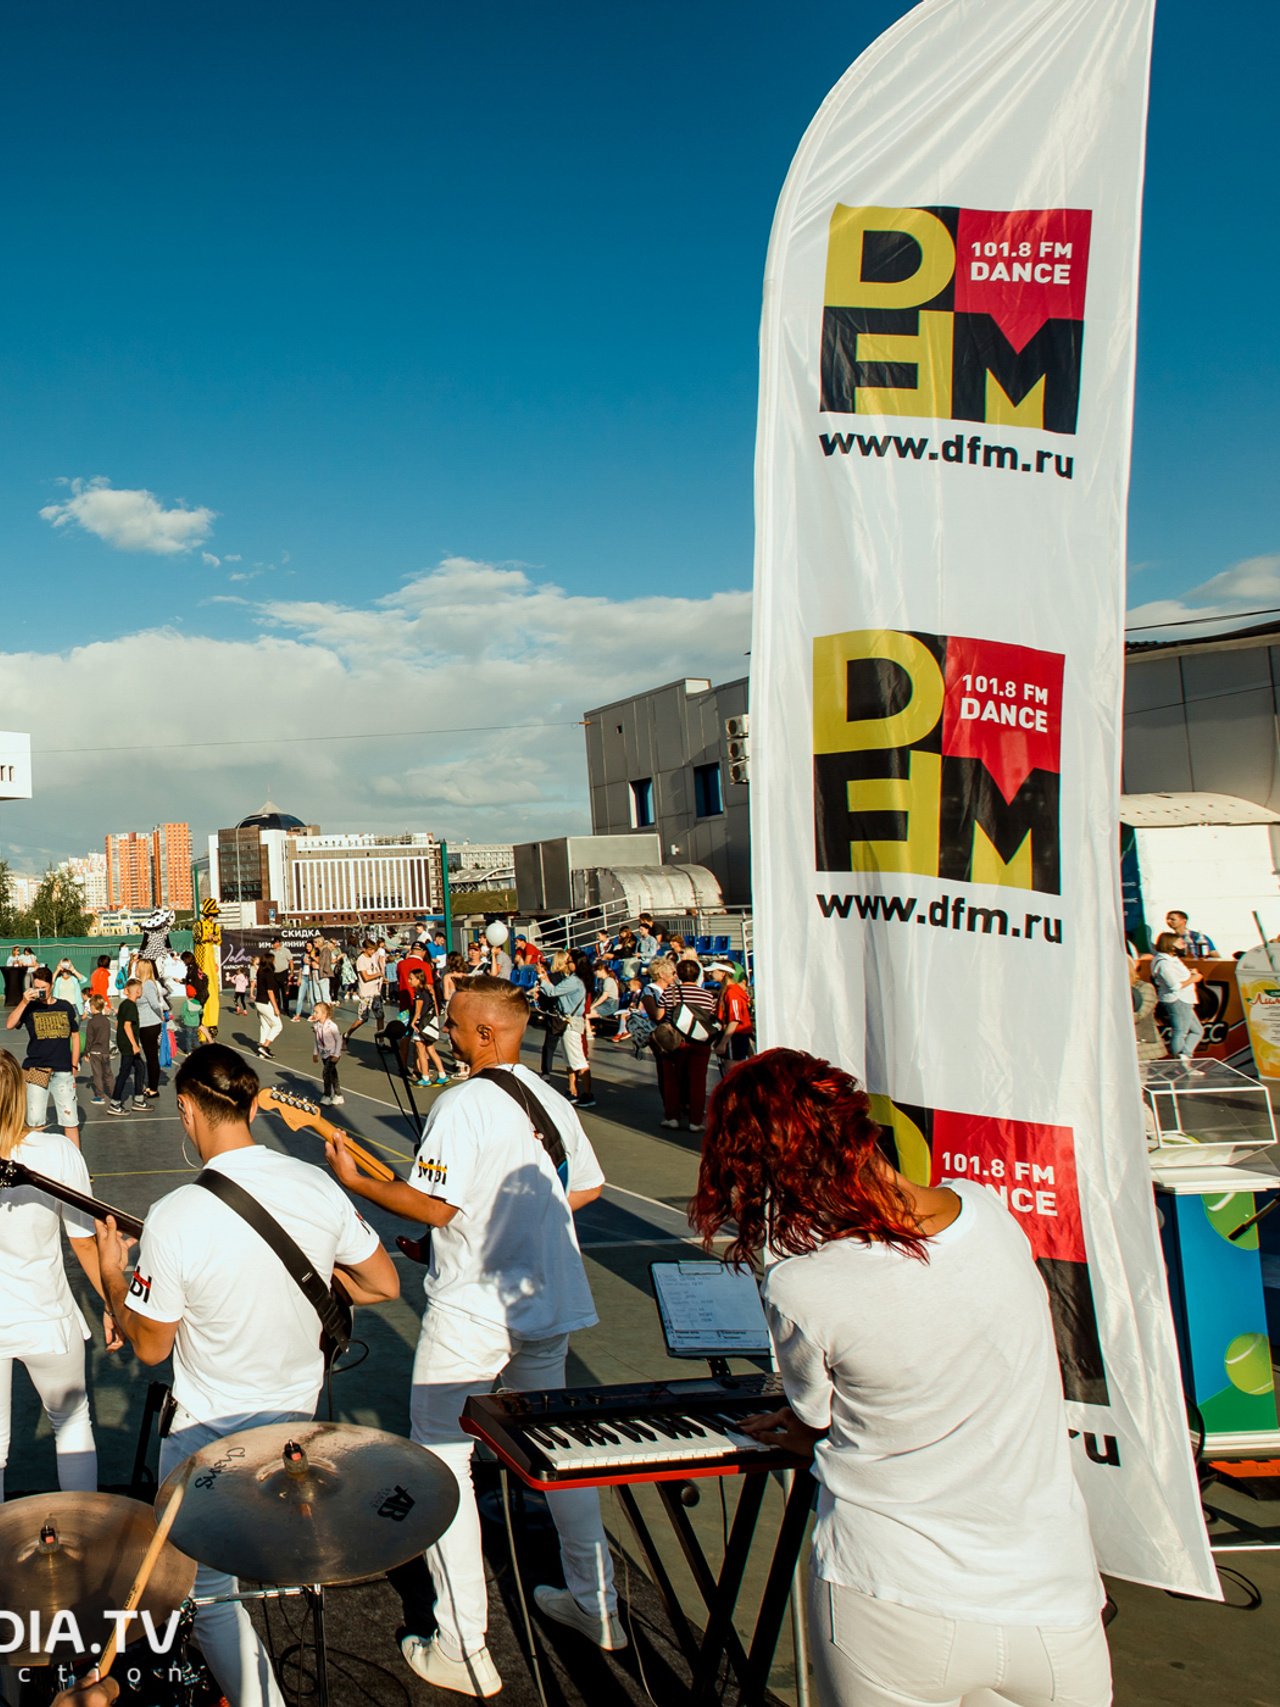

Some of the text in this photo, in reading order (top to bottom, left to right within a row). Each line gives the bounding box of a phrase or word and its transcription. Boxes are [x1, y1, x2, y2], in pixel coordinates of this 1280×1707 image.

[971, 241, 1072, 259] 101.8 FM
[970, 262, 1071, 285] DANCE
[819, 432, 1074, 480] www.dfm.ru
[962, 674, 1048, 705] 101.8 FM
[960, 697, 1048, 733] DANCE
[281, 929, 321, 938] СКИДКА
[816, 894, 1063, 944] www.dfm.ru
[942, 1151, 1055, 1185] 101.8 FM
